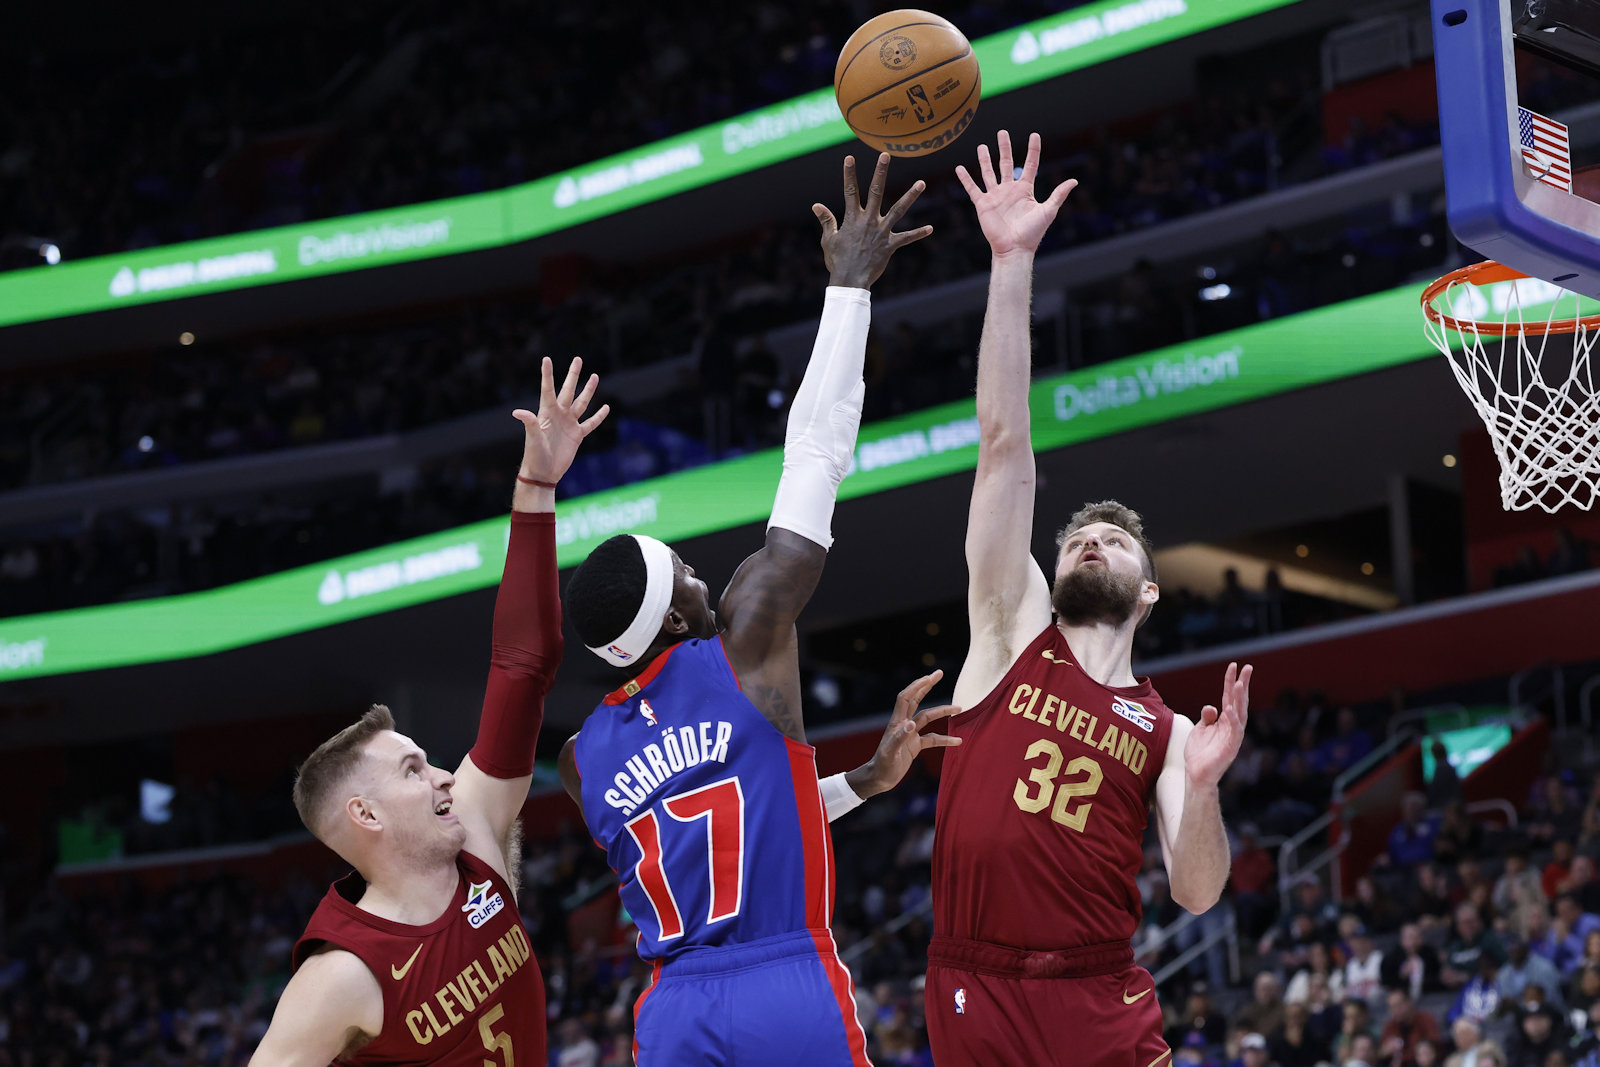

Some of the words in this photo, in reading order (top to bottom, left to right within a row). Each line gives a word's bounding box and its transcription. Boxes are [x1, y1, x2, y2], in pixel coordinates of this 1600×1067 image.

[1053, 350, 1239, 422] DeltaVision
[1008, 683, 1148, 775] CLEVELAND
[1113, 704, 1152, 731] CLIFFS
[604, 721, 733, 817] SCHRÖDER
[1013, 738, 1104, 833] 32
[624, 776, 744, 942] 17
[471, 895, 503, 926] CLIFFS
[405, 923, 530, 1045] CLEVELAND
[478, 1002, 515, 1067] 5
